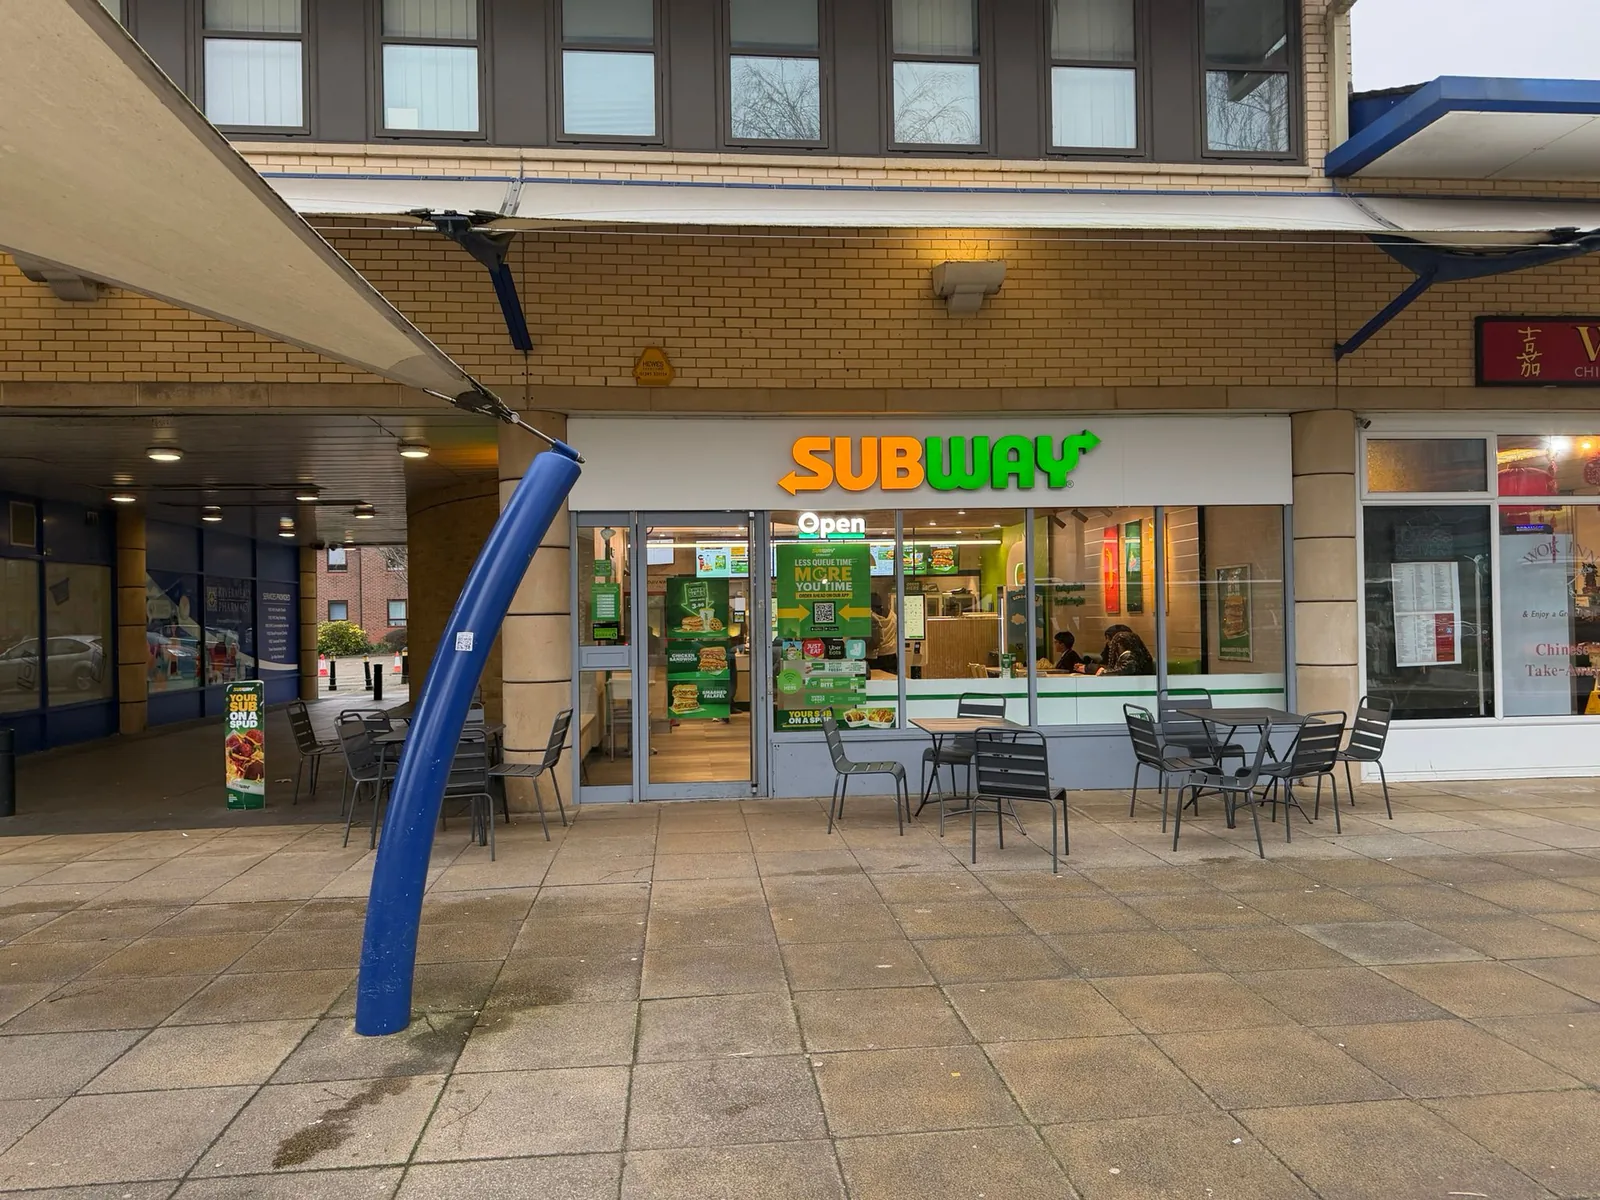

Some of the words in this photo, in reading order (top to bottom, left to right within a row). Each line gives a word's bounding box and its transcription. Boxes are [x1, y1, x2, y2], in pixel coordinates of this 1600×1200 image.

[777, 430, 1101, 496] SUBWAY
[798, 511, 867, 540] Open
[794, 558, 811, 567] LESS
[812, 558, 836, 567] QUEUE
[836, 558, 853, 566] TIME
[794, 566, 853, 582] MORE
[795, 582, 821, 592] YOU
[824, 582, 853, 592] TIME
[1522, 610, 1528, 618] &
[1531, 610, 1550, 619] Enjoy
[1536, 643, 1590, 656] Chinese
[1524, 664, 1600, 679] Take-Away
[229, 694, 258, 702] YOUR
[229, 701, 258, 712] SUB
[229, 711, 247, 721] ON
[248, 711, 258, 721] A
[788, 710, 813, 718] YOUR
[229, 720, 258, 729] SPUD
